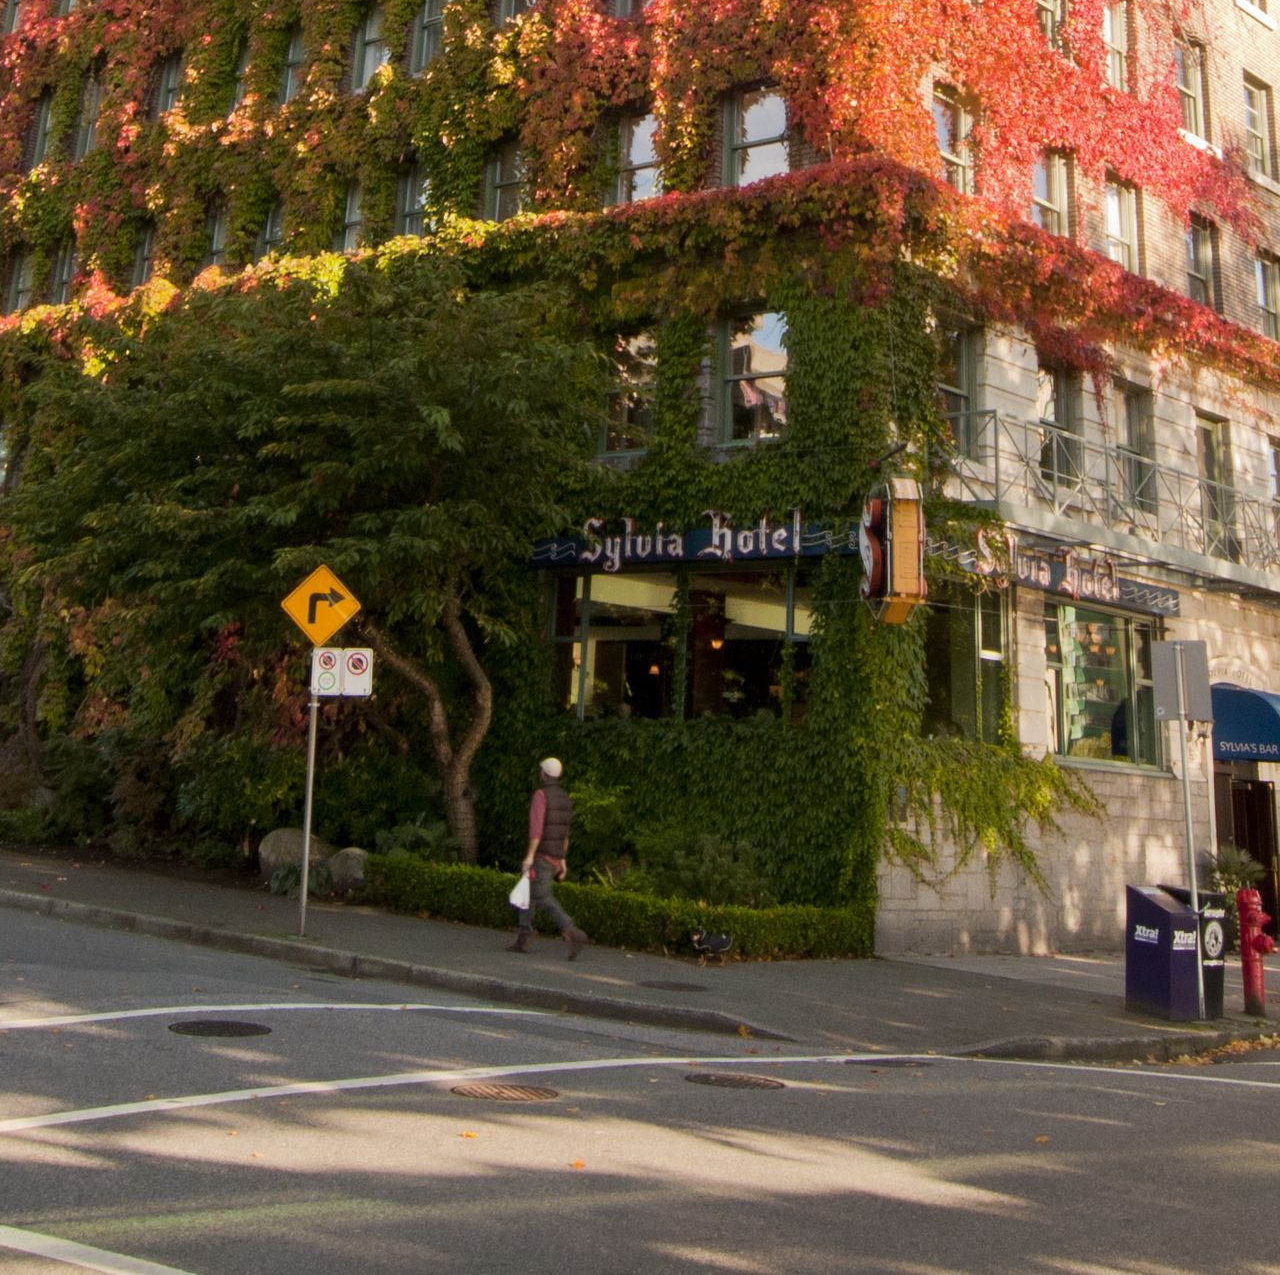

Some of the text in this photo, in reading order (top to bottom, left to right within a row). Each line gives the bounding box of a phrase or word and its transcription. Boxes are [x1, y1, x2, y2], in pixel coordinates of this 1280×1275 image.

[580, 507, 801, 573] Sylvia Hotel
[1220, 741, 1279, 754] SYLVIA'S BAR
[1134, 925, 1159, 940] Xtra!
[1173, 930, 1196, 943] Xtra!
